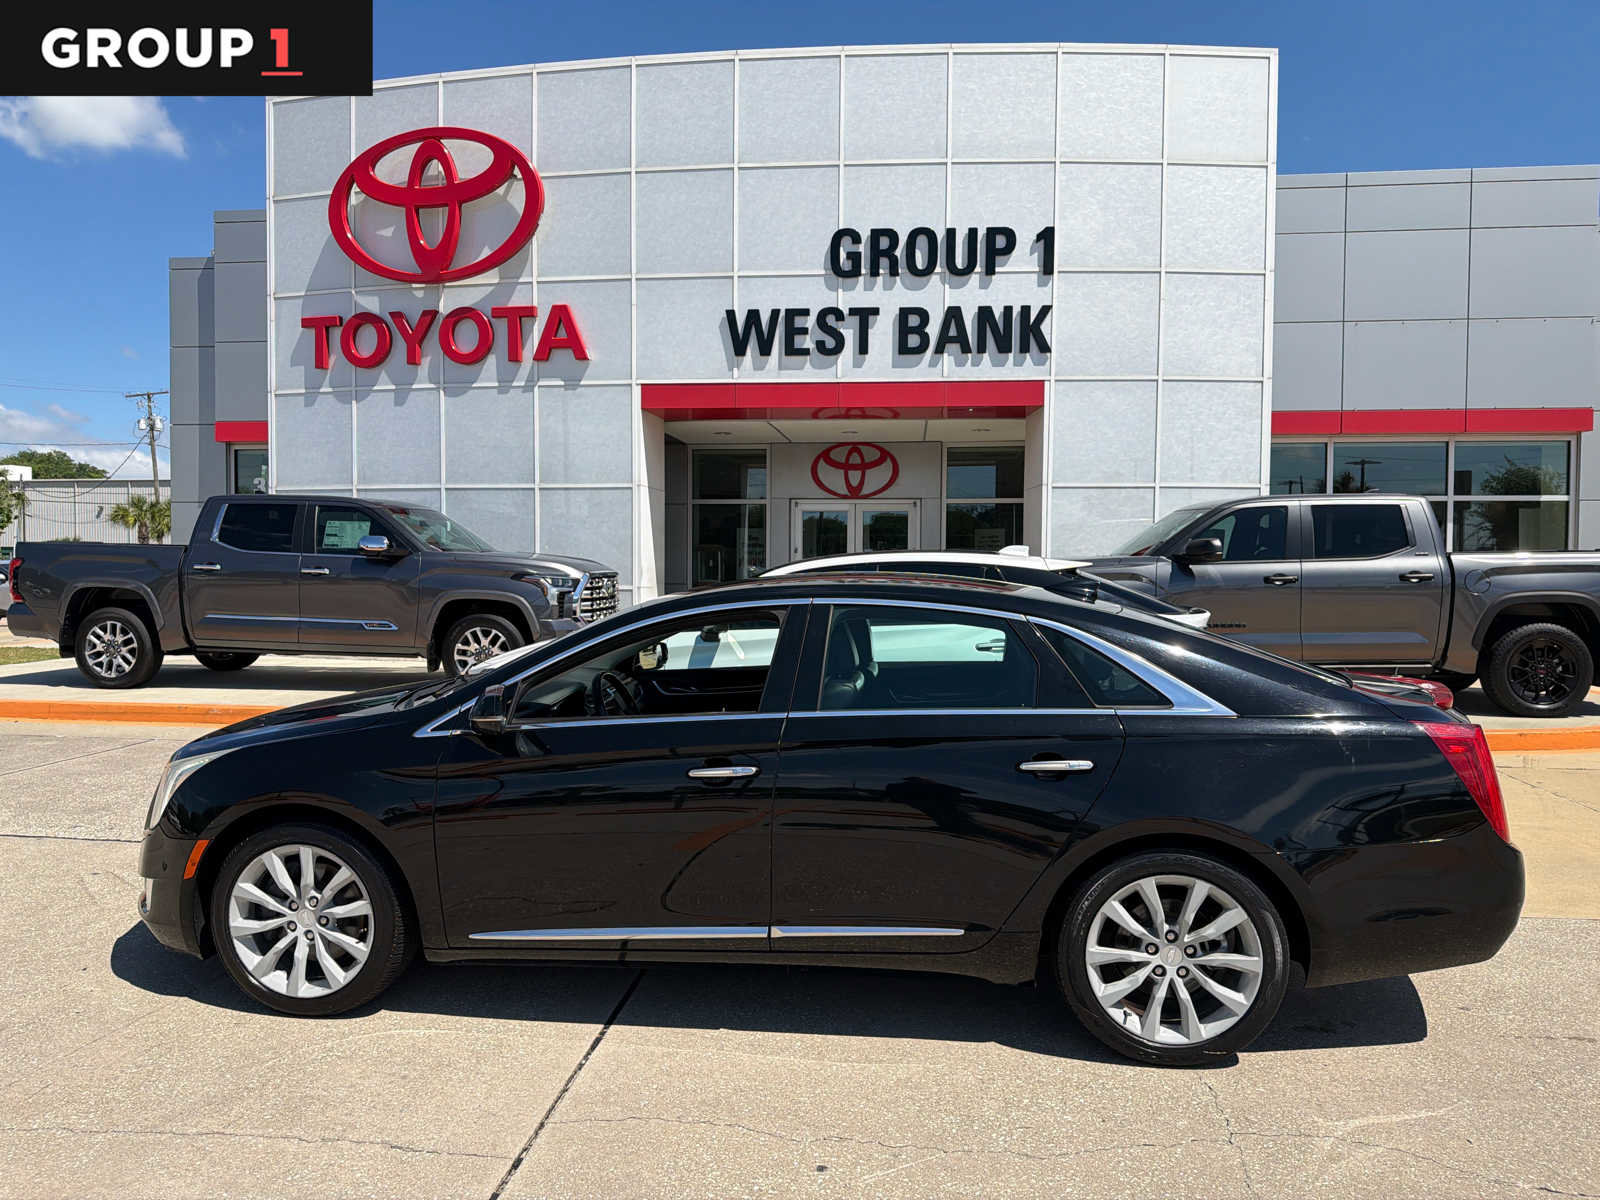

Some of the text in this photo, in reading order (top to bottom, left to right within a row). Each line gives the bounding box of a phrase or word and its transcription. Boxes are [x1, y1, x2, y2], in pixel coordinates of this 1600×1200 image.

[829, 226, 1055, 279] GROUP 1
[301, 303, 590, 370] TOYOTA
[725, 304, 1054, 358] WEST BANK
